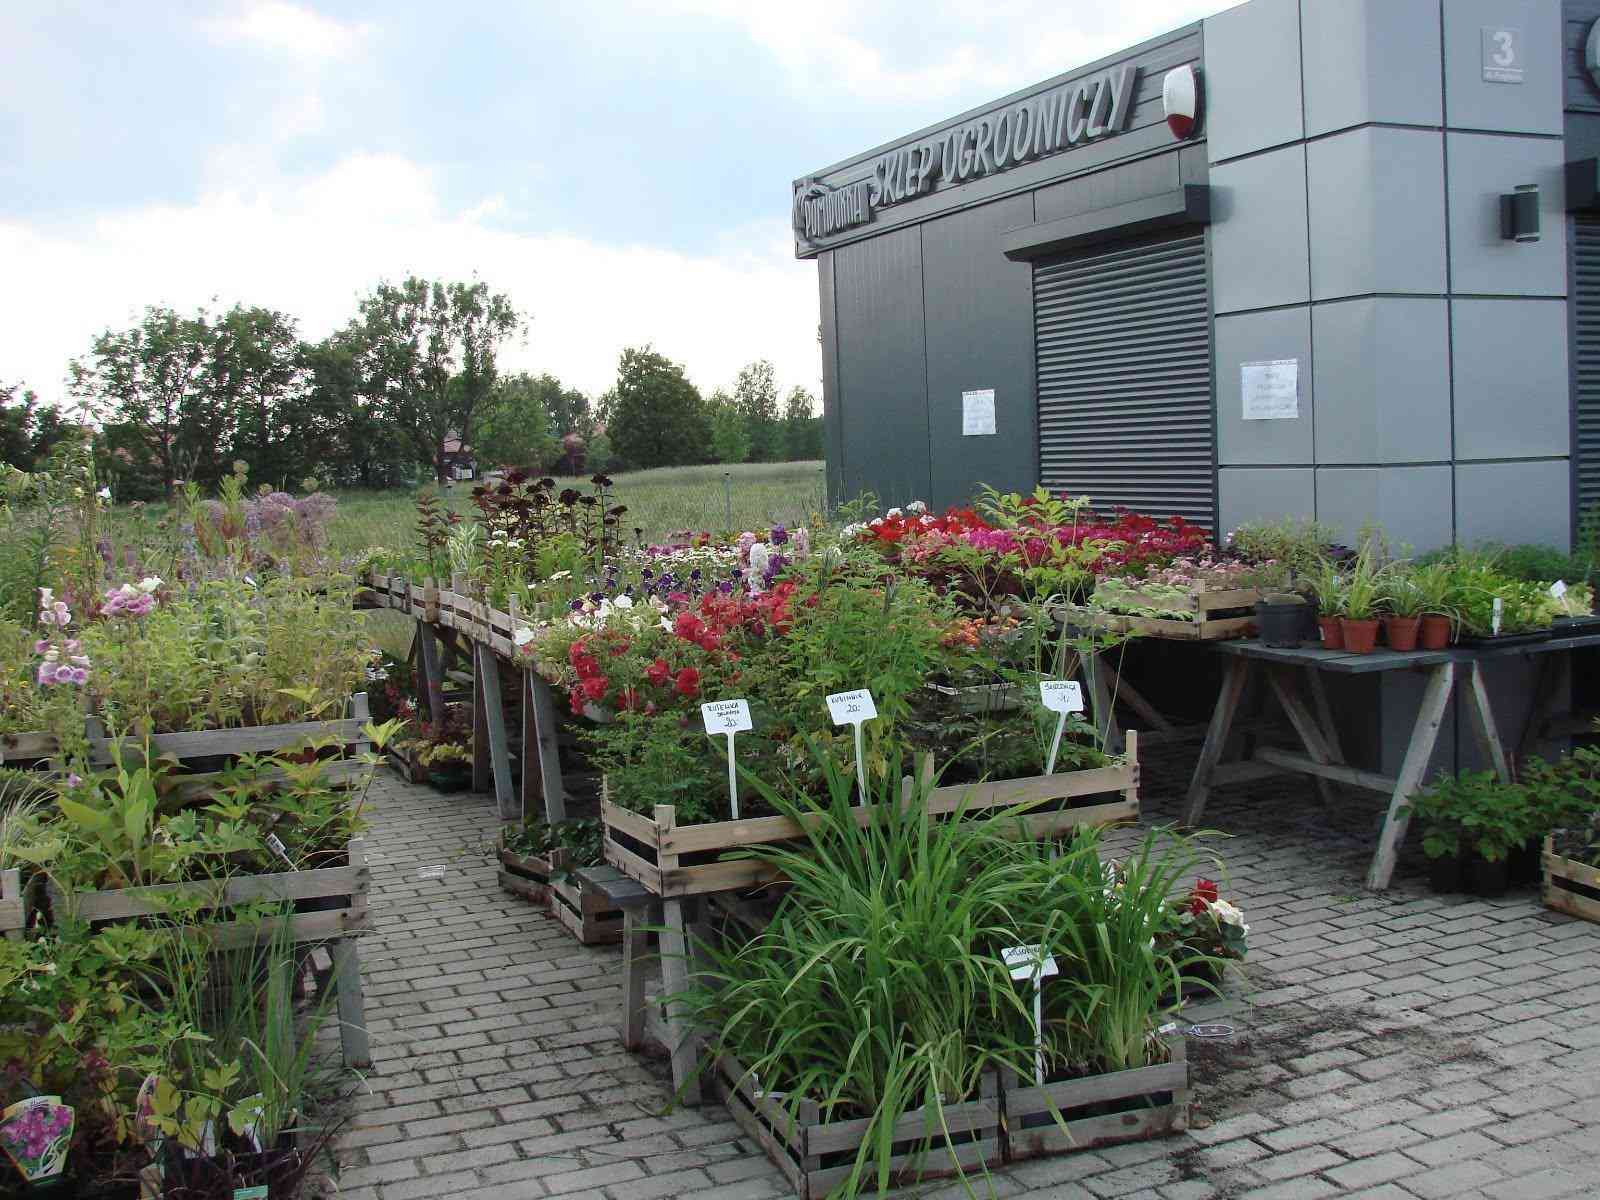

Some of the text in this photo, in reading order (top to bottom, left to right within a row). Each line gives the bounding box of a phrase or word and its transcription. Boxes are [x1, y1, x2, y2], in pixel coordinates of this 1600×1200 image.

[1492, 31, 1514, 66] 3
[869, 63, 1138, 207] SKLEP OGRODNICZY
